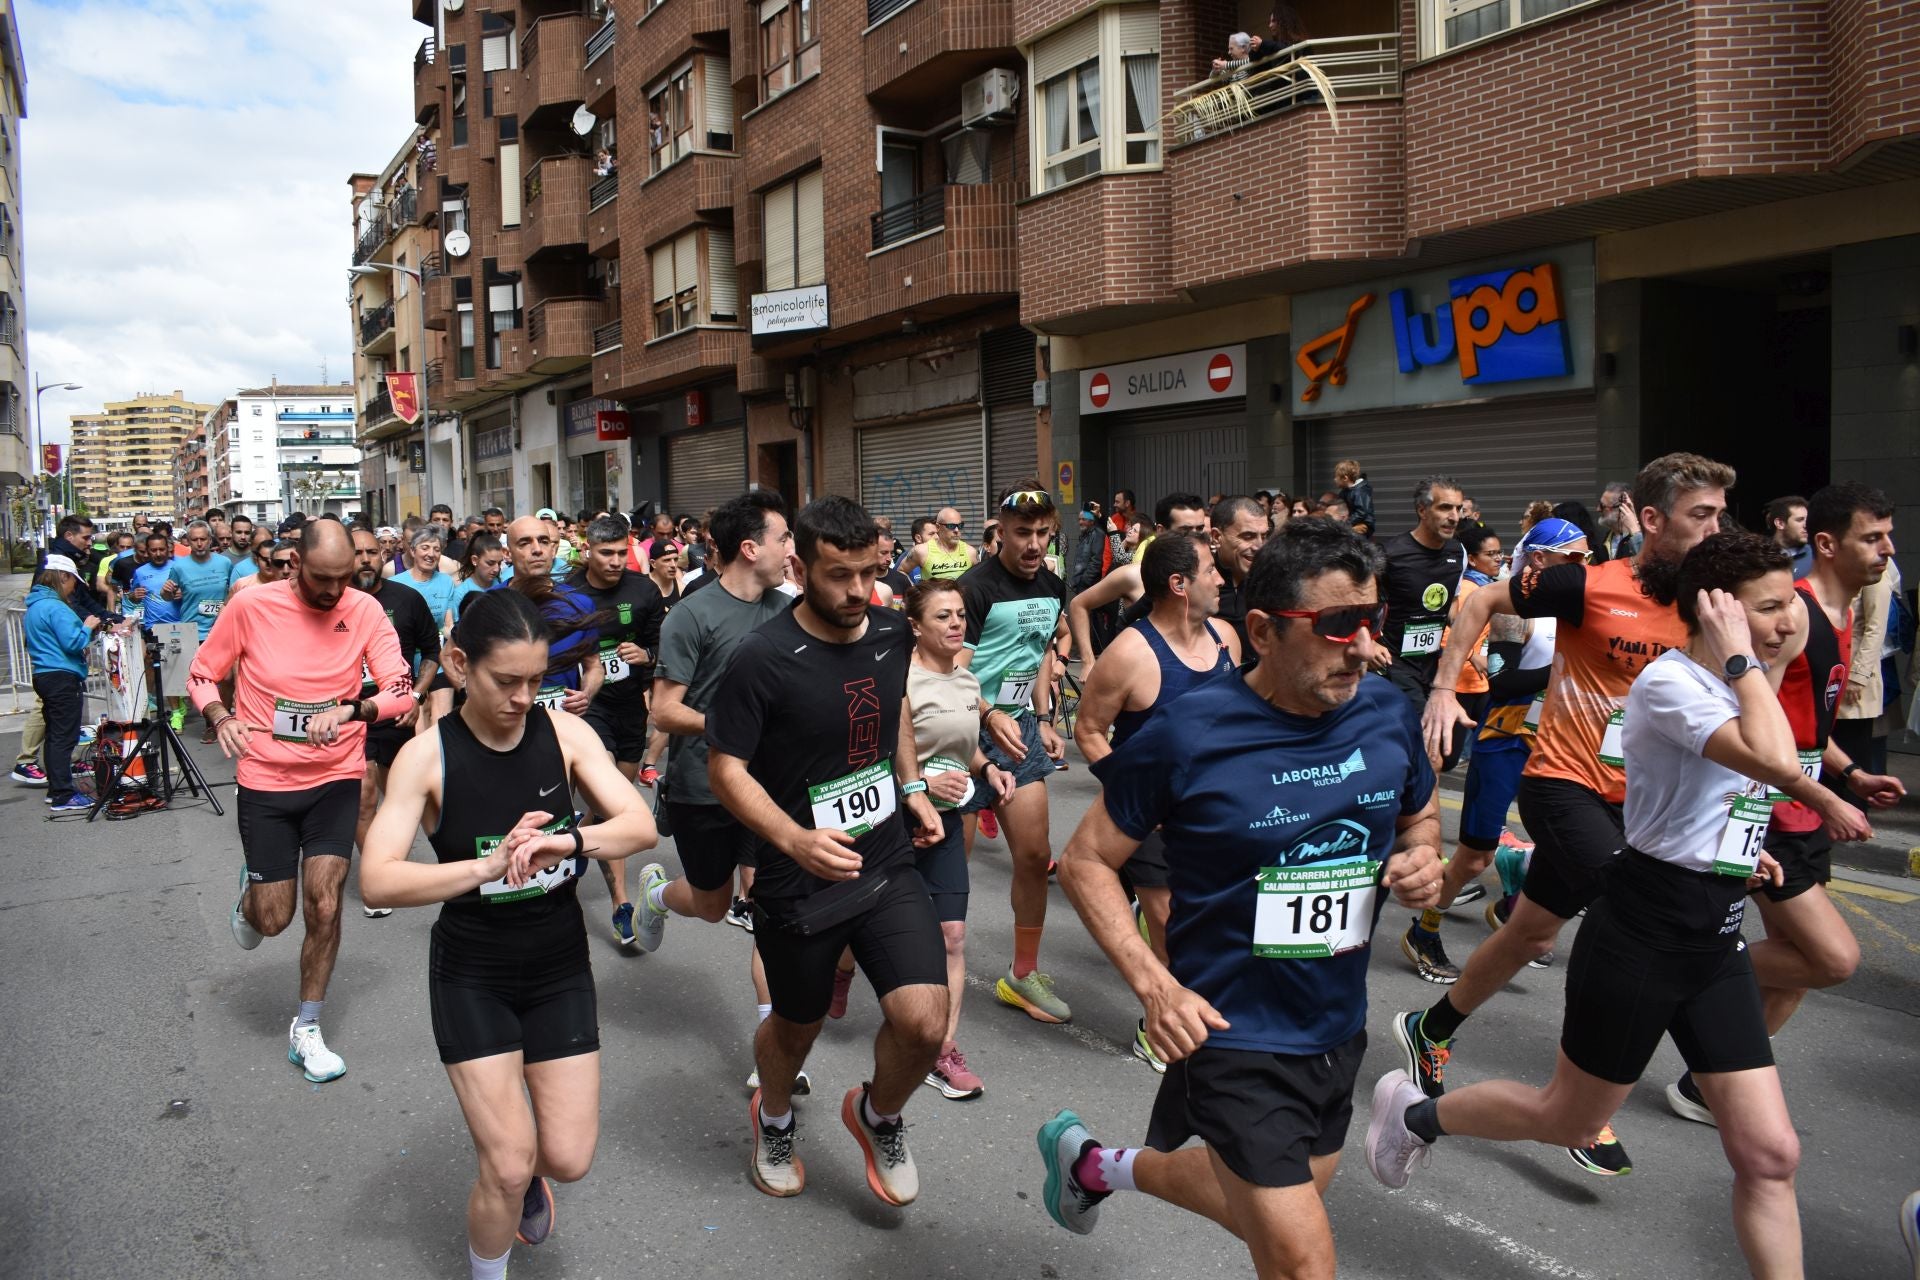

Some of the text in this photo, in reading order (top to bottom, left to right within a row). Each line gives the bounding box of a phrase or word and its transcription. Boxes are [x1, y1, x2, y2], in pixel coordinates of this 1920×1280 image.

[752, 294, 825, 316] @monicolorlife
[1388, 263, 1562, 380] lupa
[1127, 368, 1187, 396] SALIDA
[204, 604, 220, 613] 275
[1412, 632, 1435, 648] 196
[1608, 636, 1647, 656] VIANA
[1012, 682, 1030, 700] 77
[289, 714, 312, 732] 18
[829, 776, 856, 790] CARRERA
[856, 765, 881, 780] POPULAR
[1272, 764, 1339, 785] LABORAL
[1313, 776, 1342, 787] kutxa
[832, 785, 881, 824] 190
[1357, 793, 1371, 804] LA
[1249, 813, 1311, 829] APALATEGUI
[1276, 866, 1366, 880] XV CARRERA POPULAR
[1339, 879, 1348, 888] LA
[1286, 891, 1350, 935] 181
